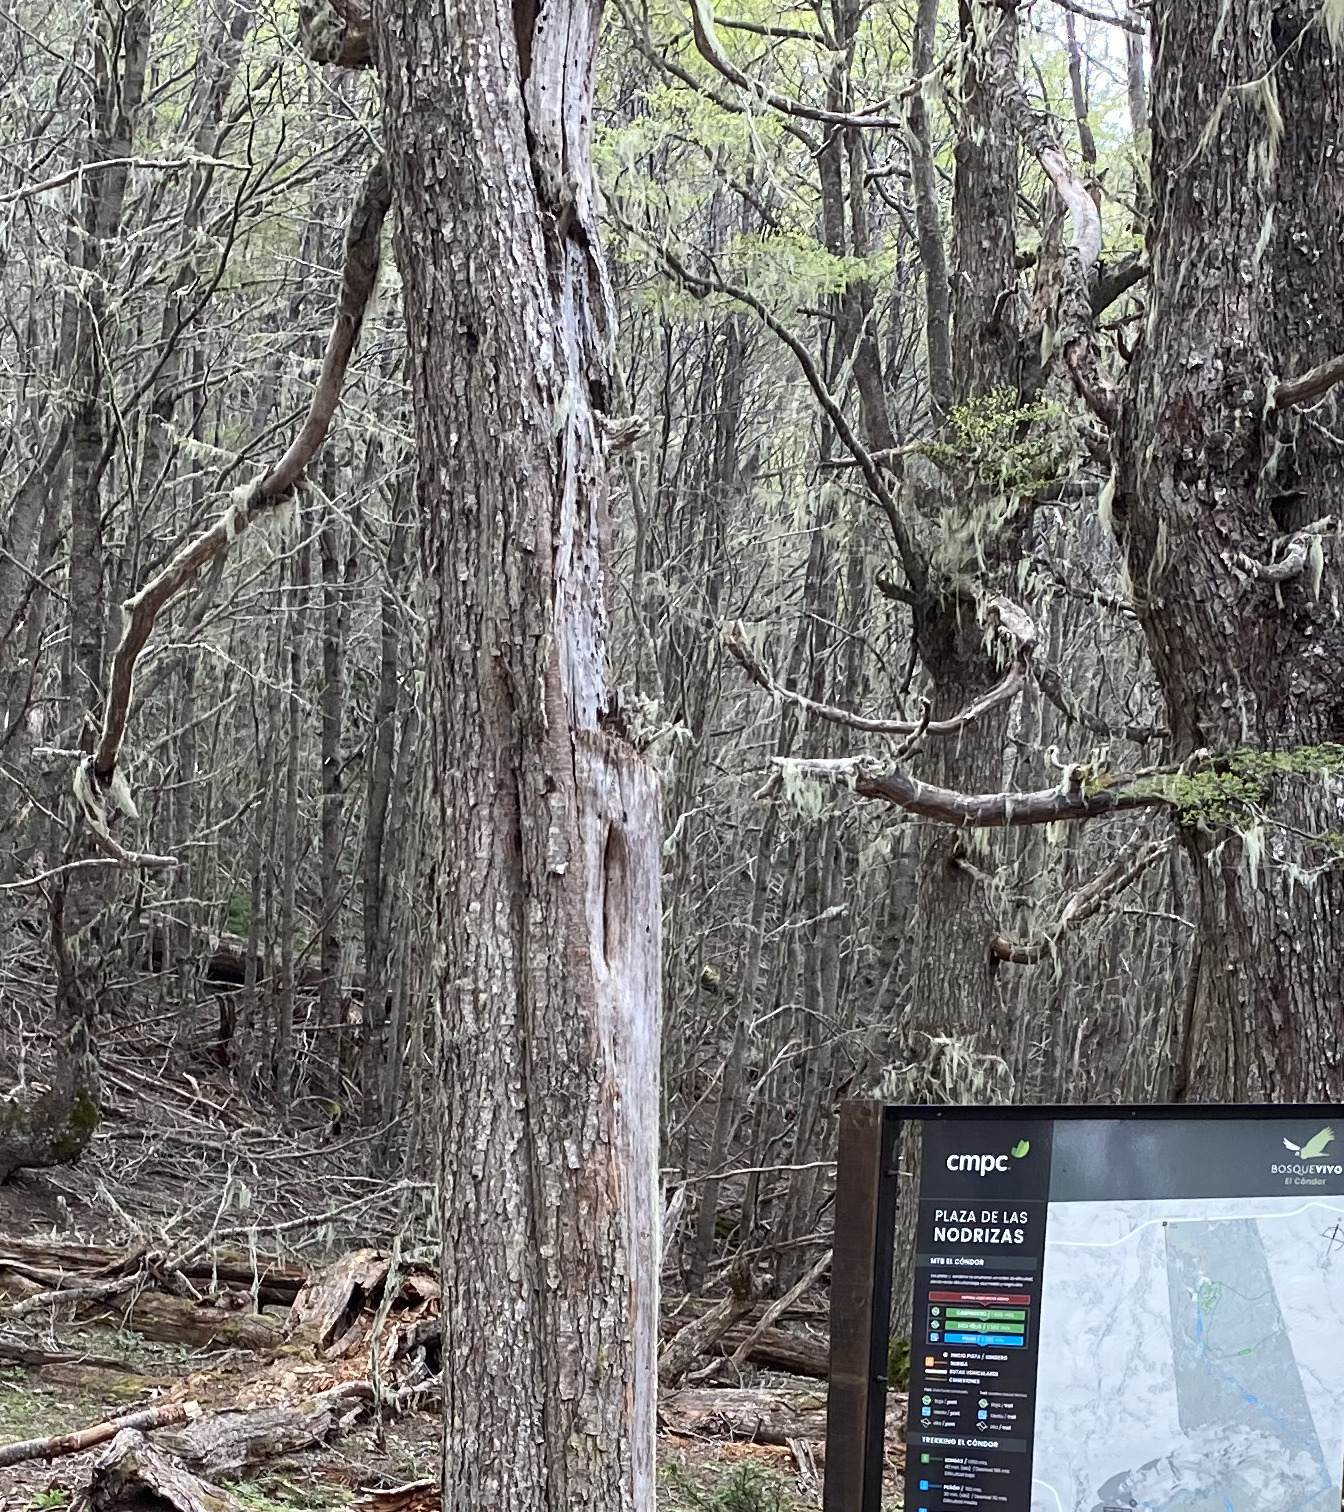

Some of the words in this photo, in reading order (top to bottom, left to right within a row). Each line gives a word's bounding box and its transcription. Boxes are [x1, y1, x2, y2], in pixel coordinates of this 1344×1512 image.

[946, 1153, 1009, 1177] cmpc
[1270, 1164, 1343, 1176] BOSQUEVIVO
[934, 1209, 976, 1223] PLAZA
[981, 1210, 998, 1224] DE
[1003, 1211, 1028, 1224] LAS
[933, 1227, 1025, 1244] NODRIZAS
